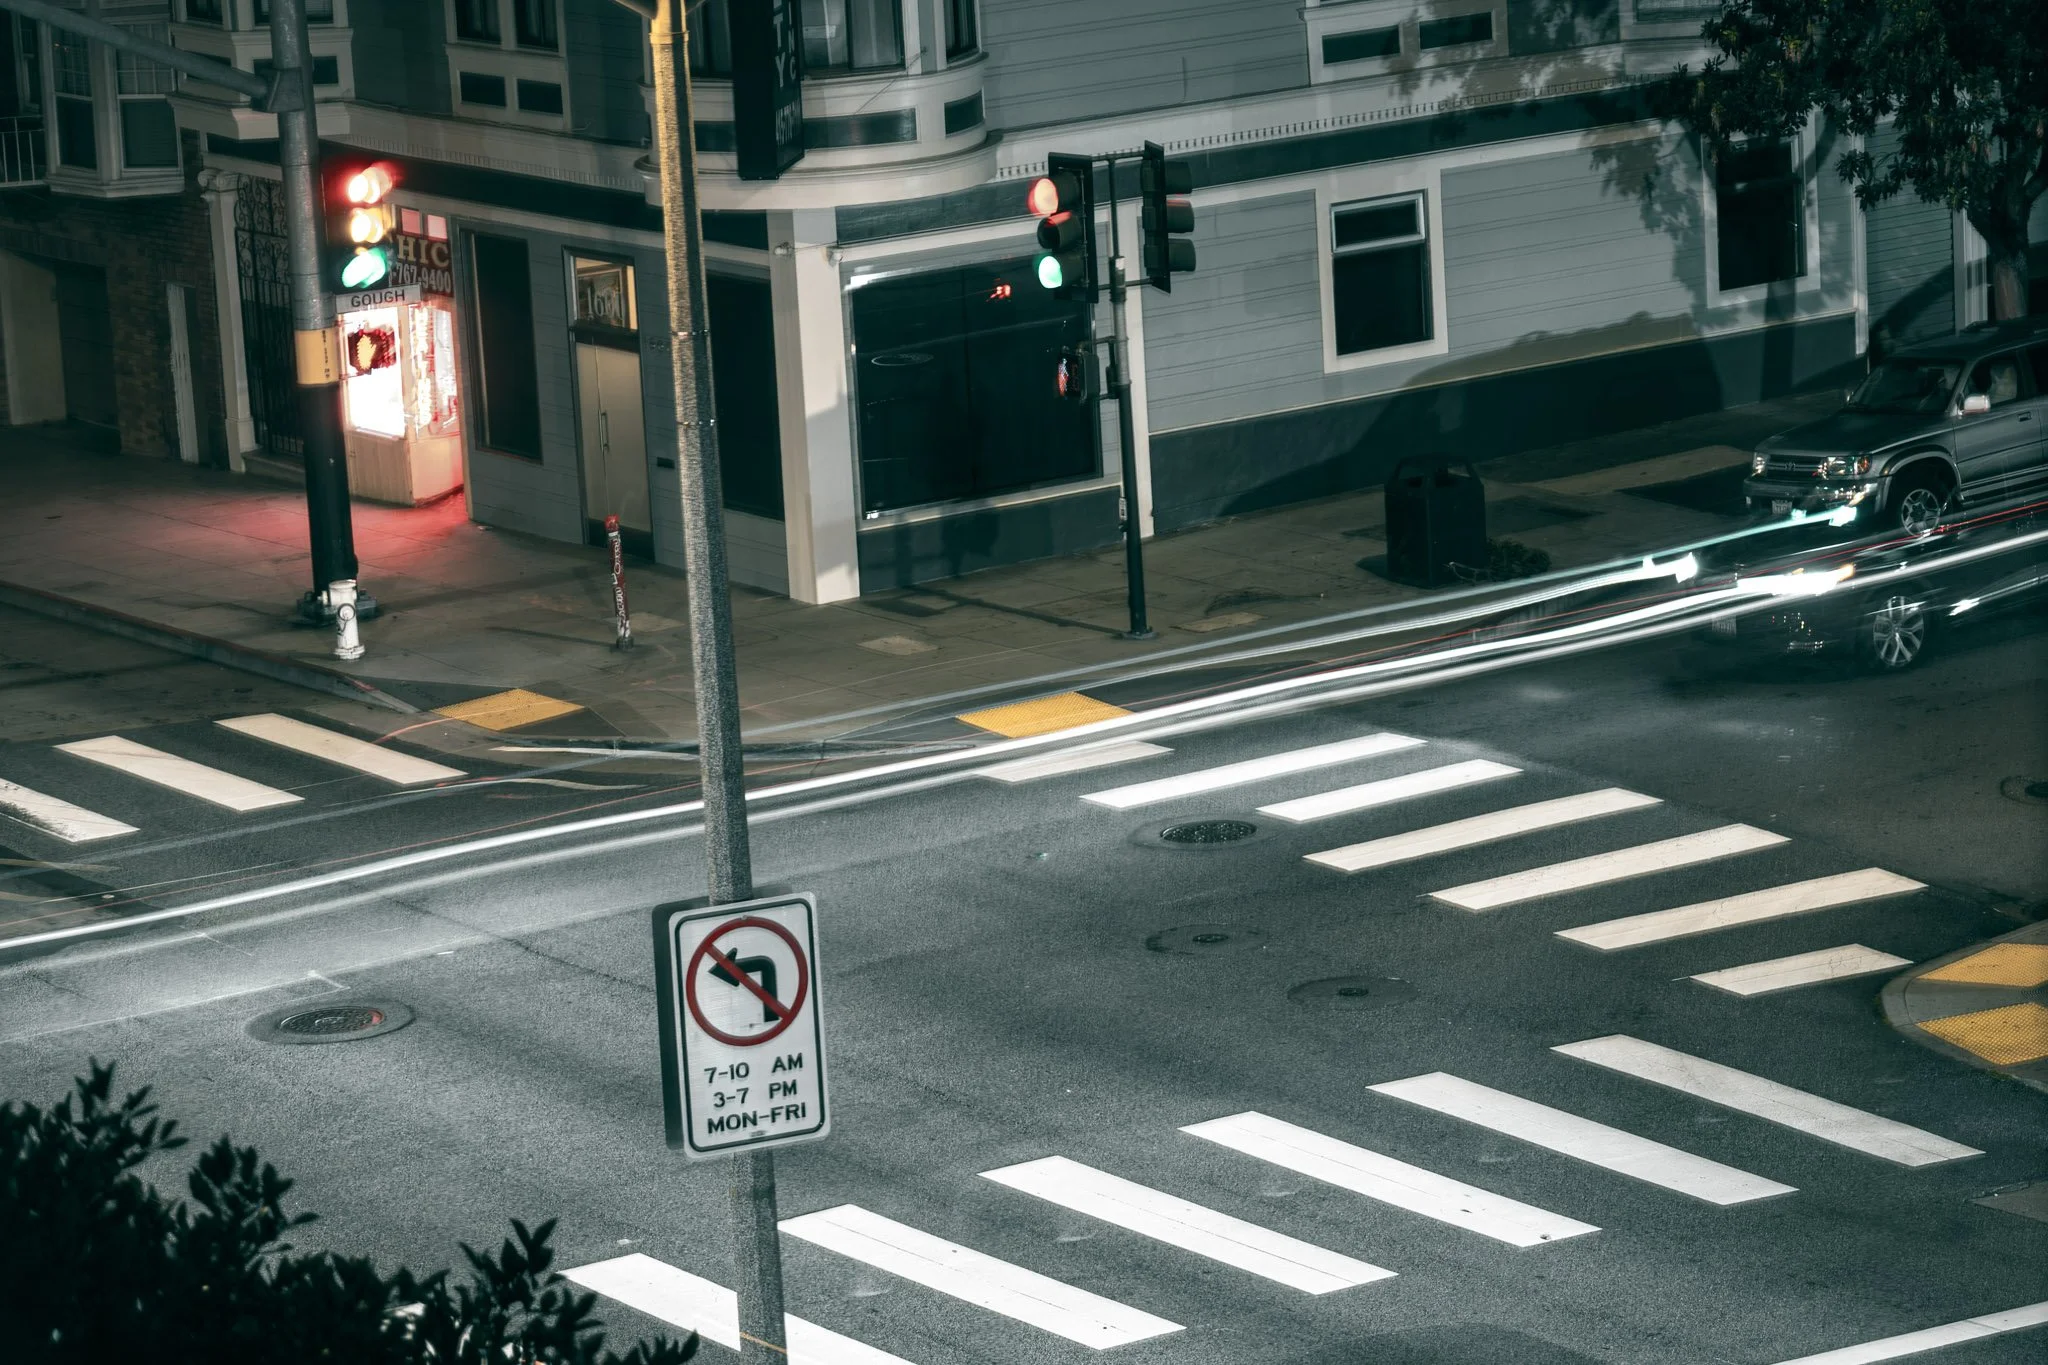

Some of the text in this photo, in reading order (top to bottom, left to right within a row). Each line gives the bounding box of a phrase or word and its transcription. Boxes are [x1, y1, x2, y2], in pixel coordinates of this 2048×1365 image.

[388, 233, 450, 268] HIC
[351, 289, 405, 308] GOUGH
[704, 1052, 803, 1084] 7-10 AM
[713, 1079, 797, 1108] 3-7 PM
[707, 1102, 806, 1134] MON-FRI
